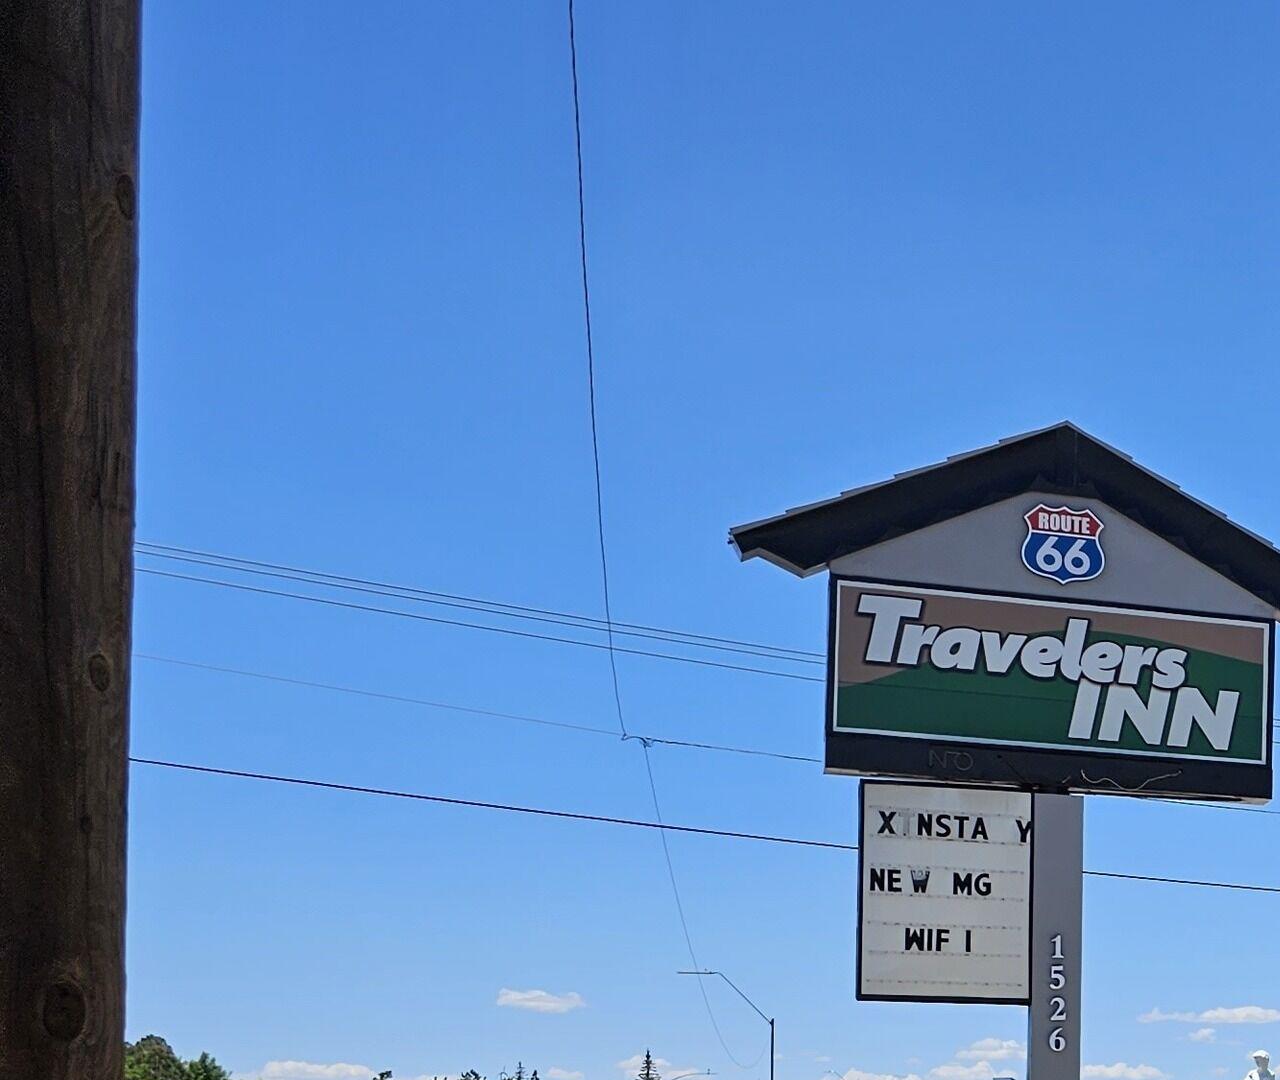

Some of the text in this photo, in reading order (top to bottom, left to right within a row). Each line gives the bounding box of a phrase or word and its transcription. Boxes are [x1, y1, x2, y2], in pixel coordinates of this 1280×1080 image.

[1038, 511, 1091, 534] ROUTE
[1036, 536, 1091, 575] 66
[857, 593, 1187, 690] Travelers
[1067, 678, 1240, 751] INN
[953, 872, 992, 896] MG
[1049, 934, 1067, 1052] 1526
